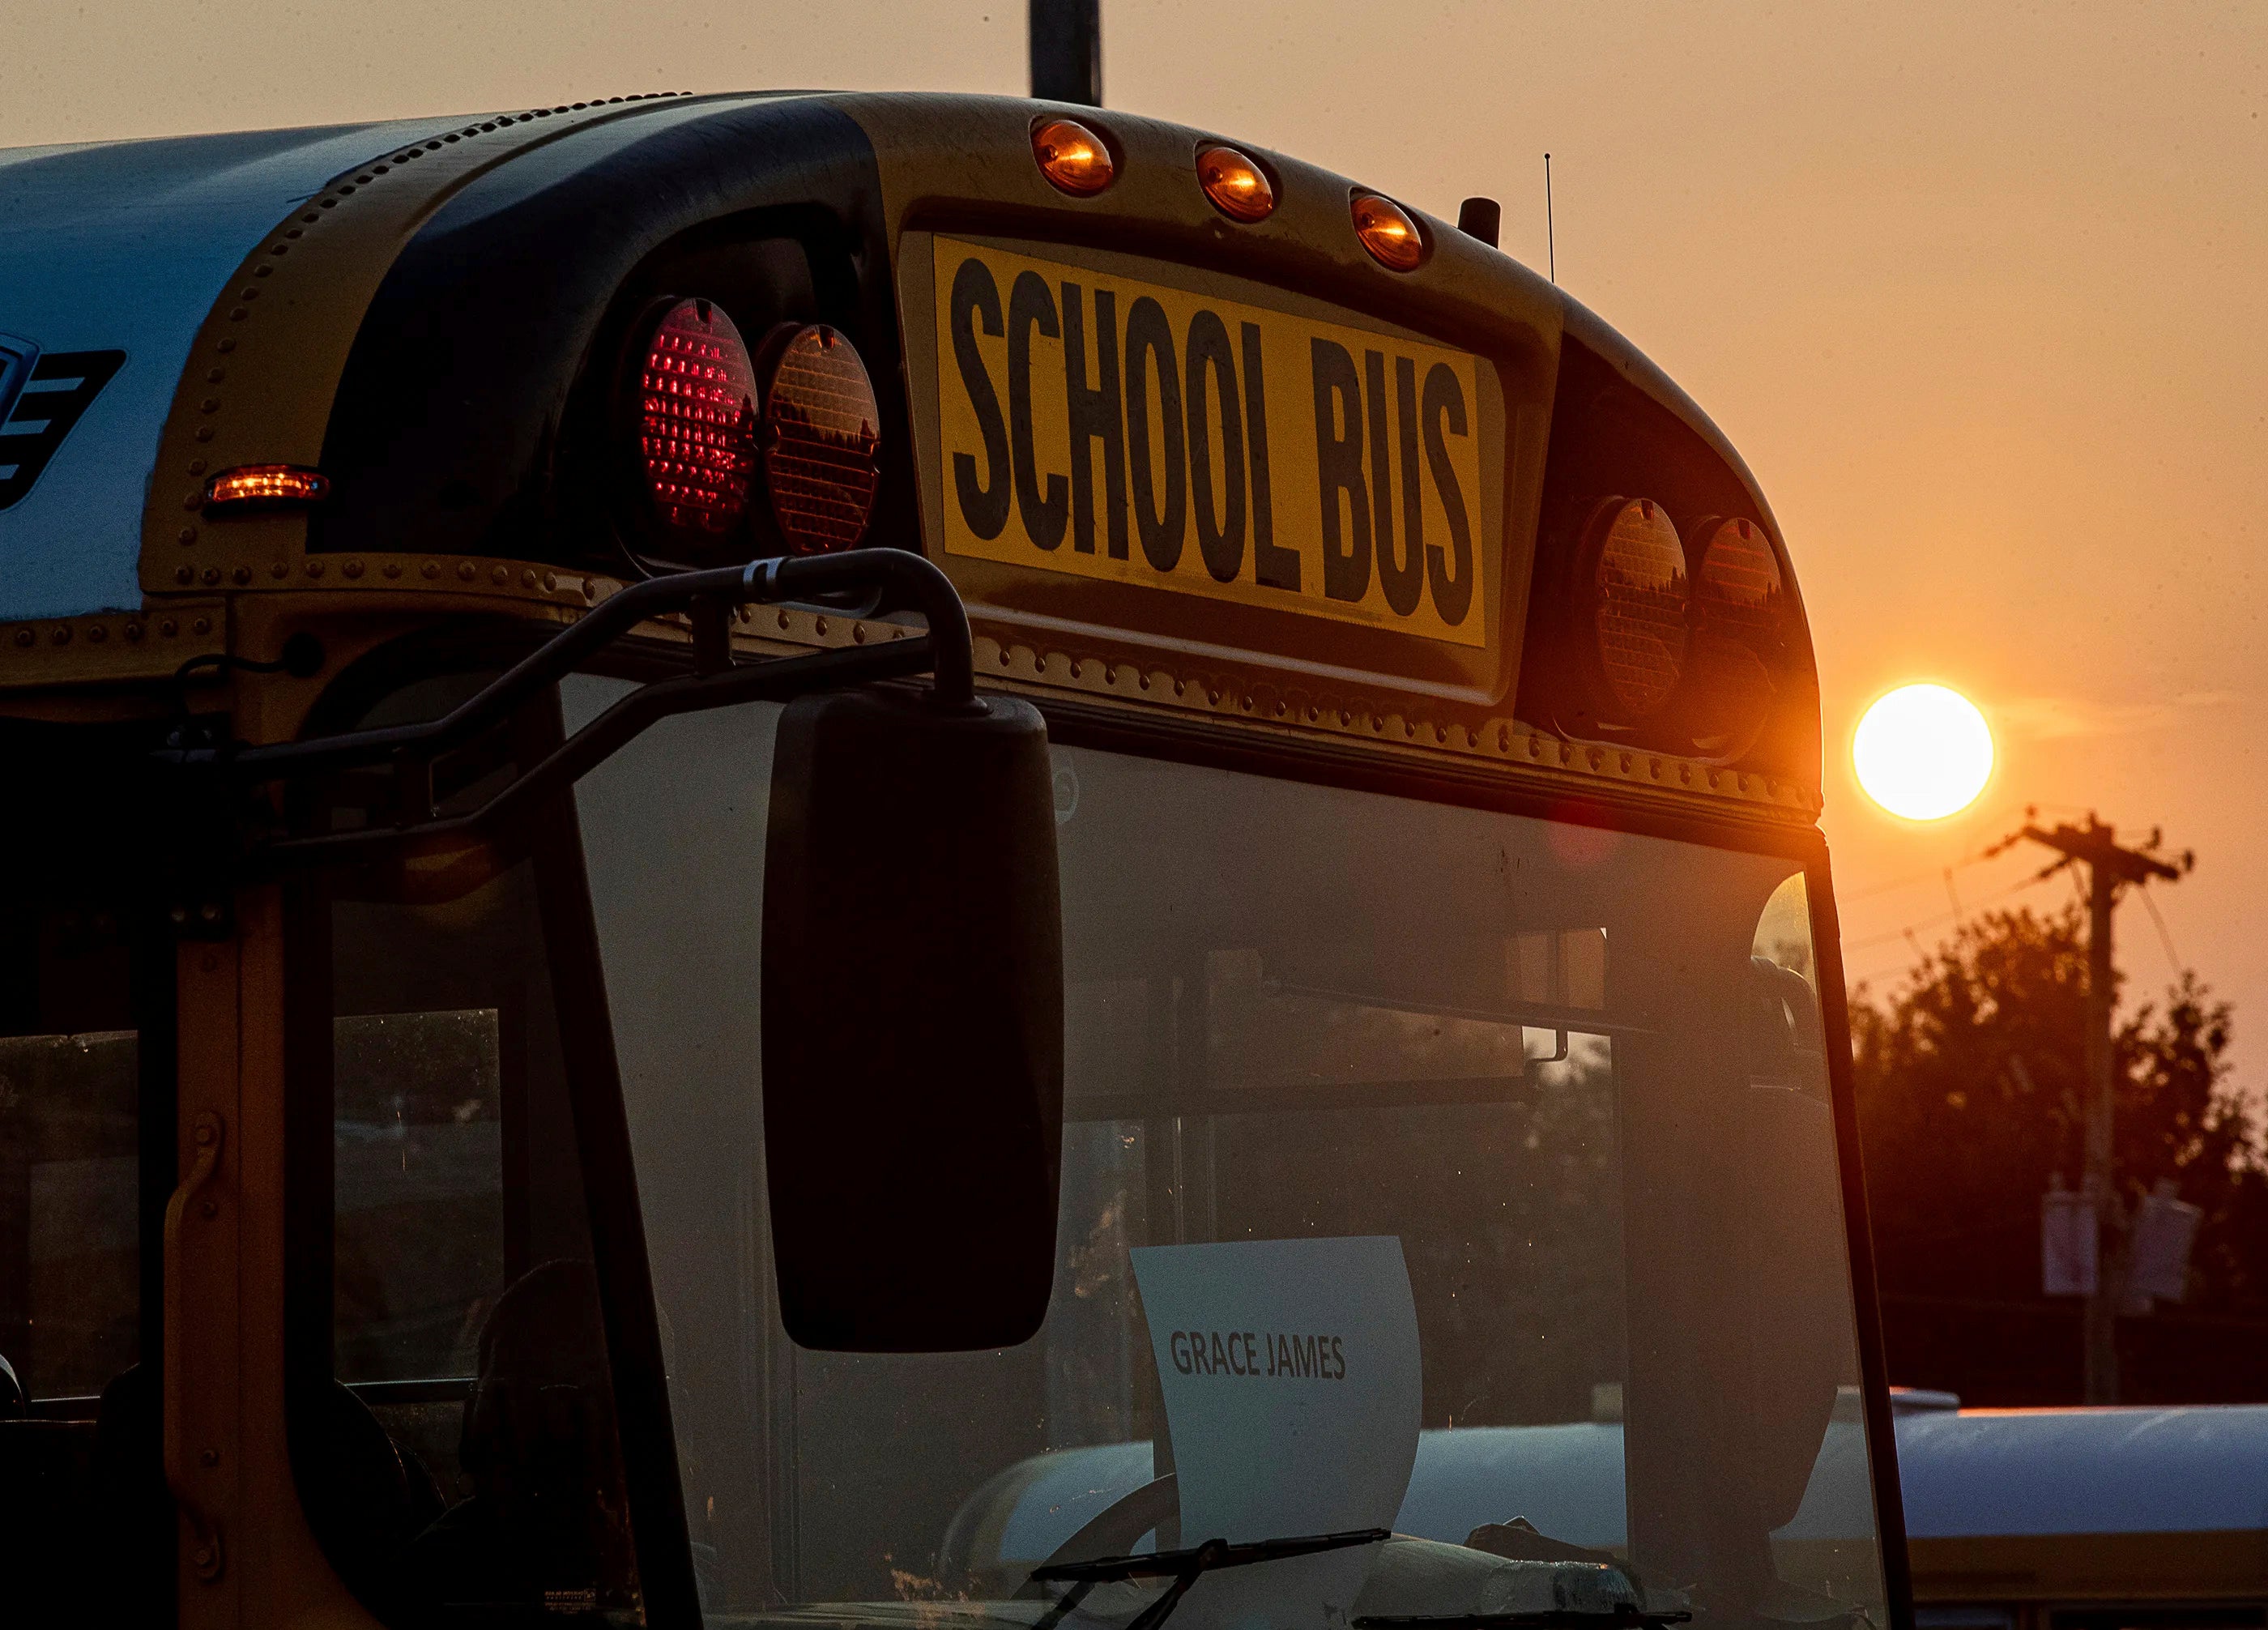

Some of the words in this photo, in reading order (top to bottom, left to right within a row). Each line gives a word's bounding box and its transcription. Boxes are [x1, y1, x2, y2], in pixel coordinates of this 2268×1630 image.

[950, 258, 1301, 592] SCHOOL
[1311, 337, 1473, 626] BUS
[1170, 1330, 1260, 1376] GRACE
[1266, 1333, 1346, 1380] JAMES
